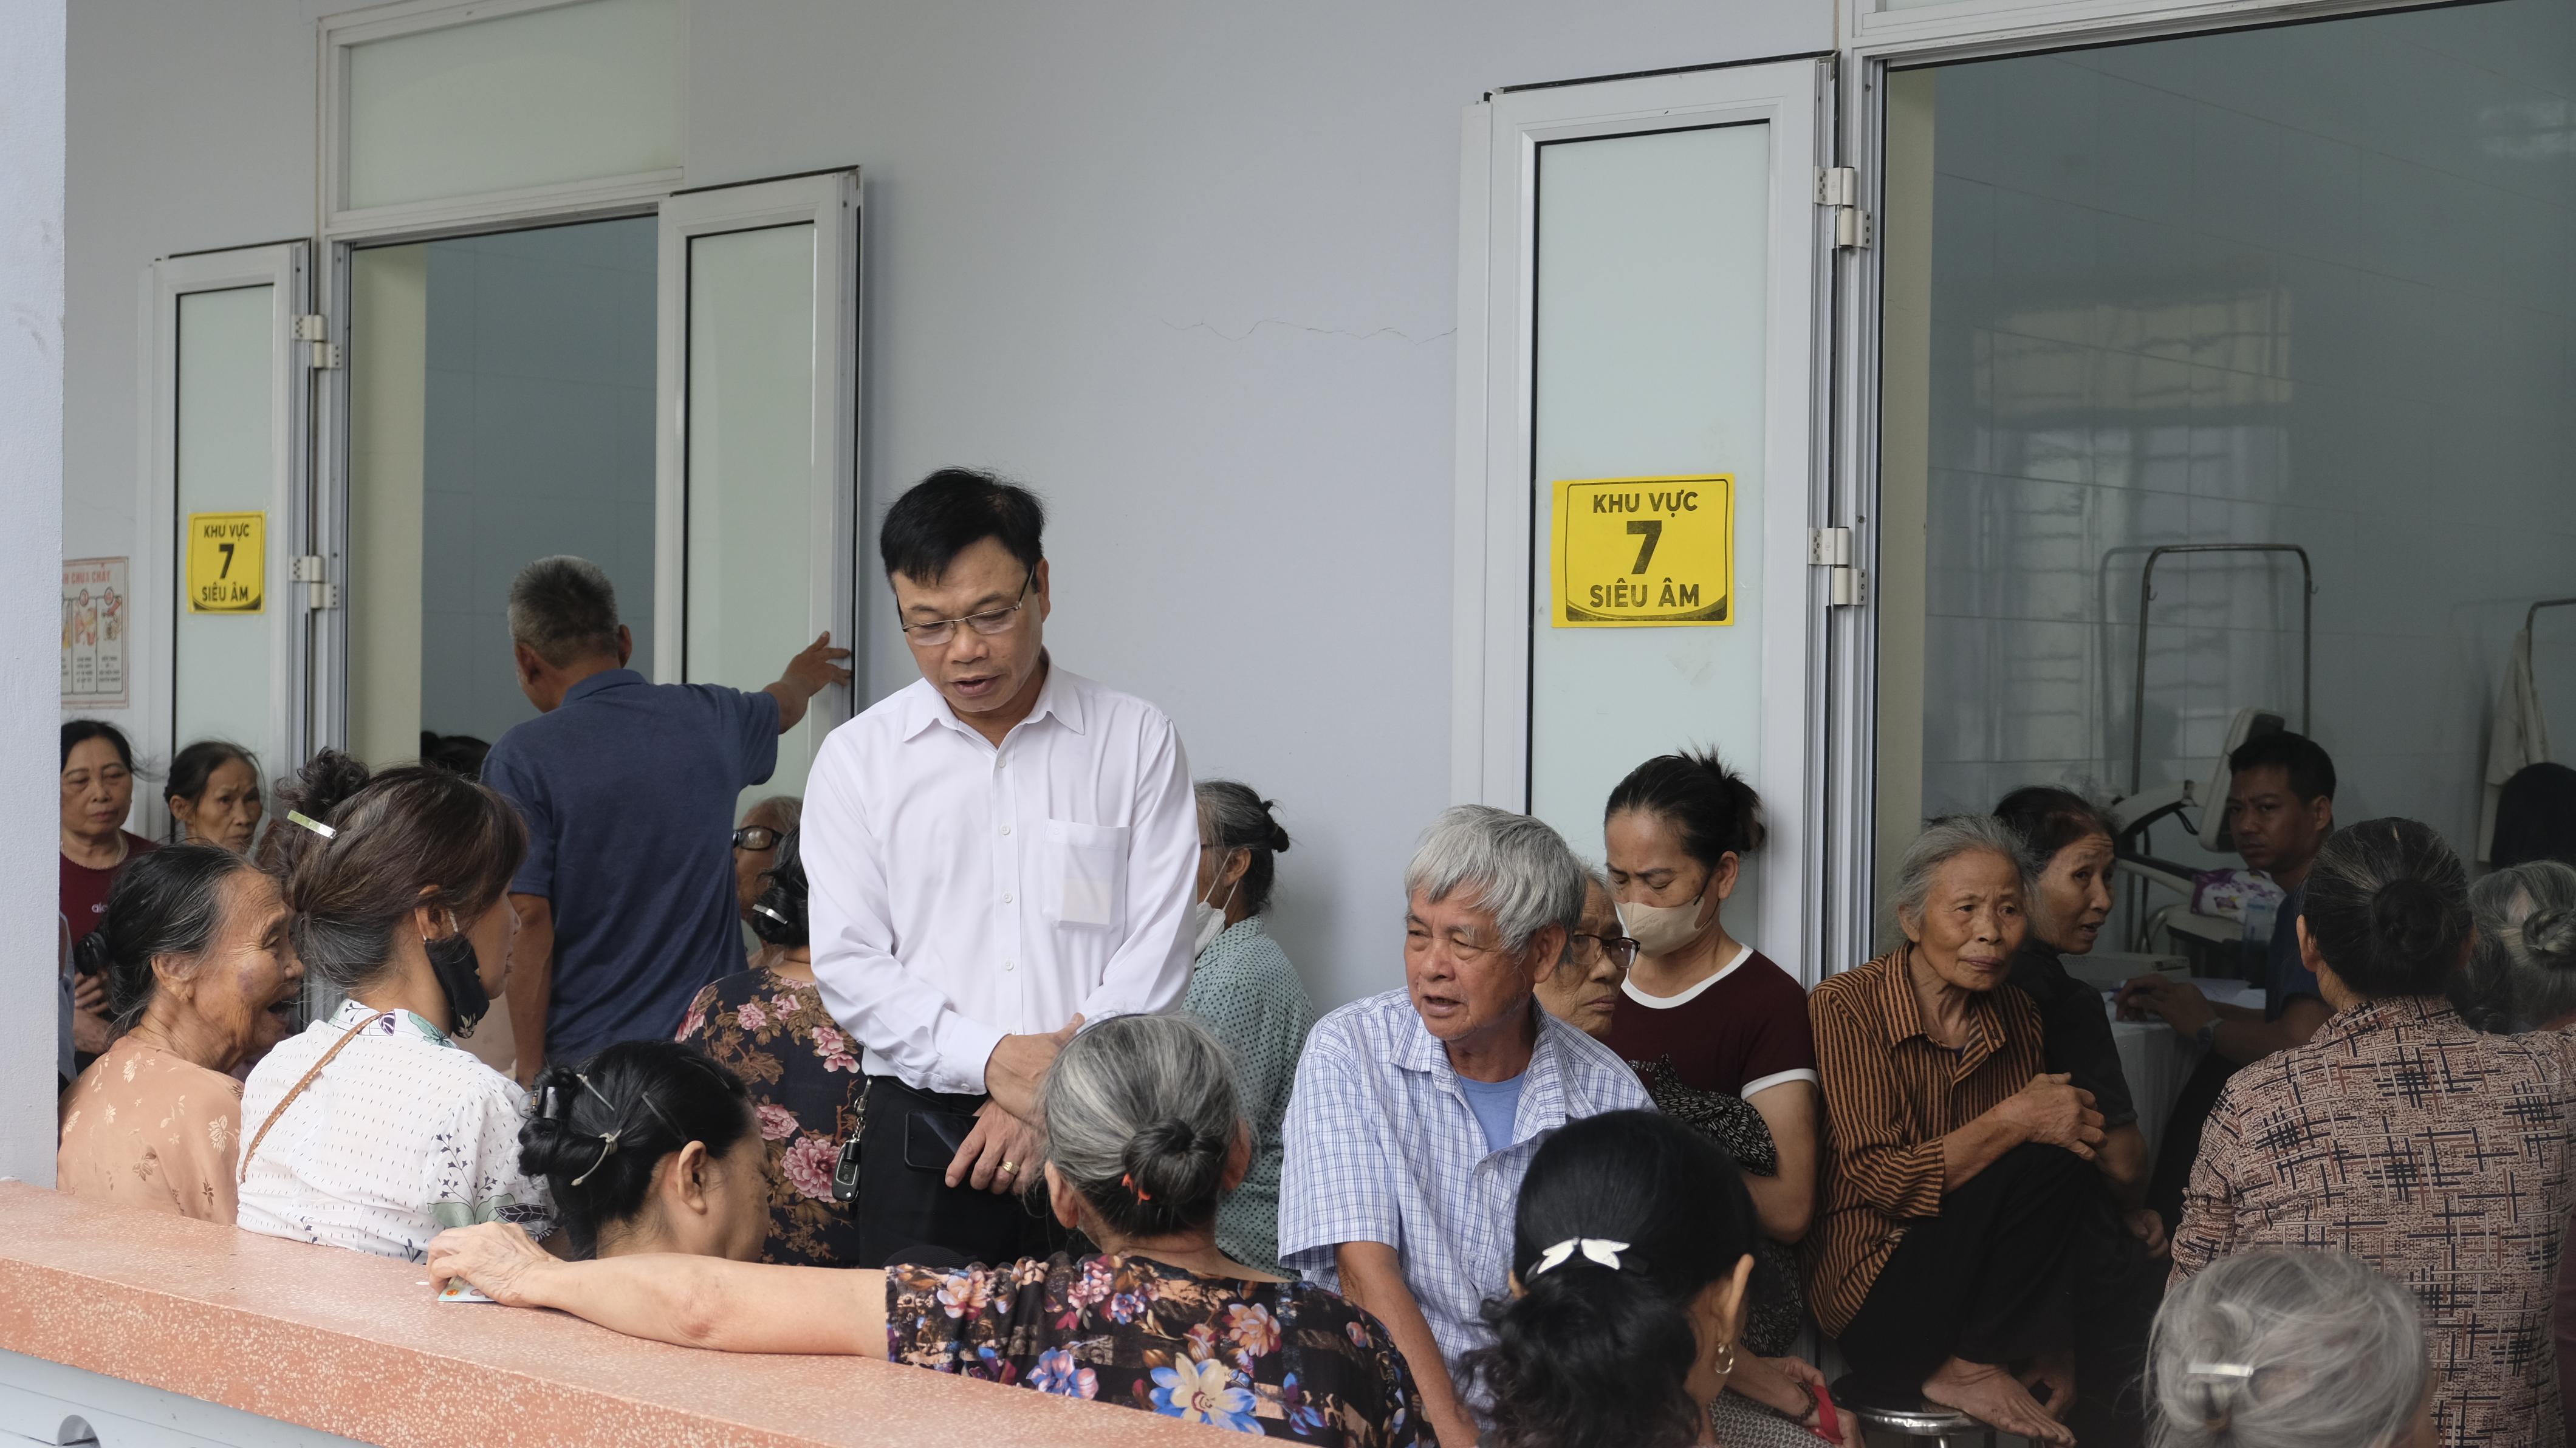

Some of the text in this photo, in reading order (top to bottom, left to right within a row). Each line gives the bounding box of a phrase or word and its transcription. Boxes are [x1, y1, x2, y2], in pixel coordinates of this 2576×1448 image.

[1592, 489, 1699, 517] KHU VỰC
[204, 522, 250, 542] KHU VỰC
[219, 543, 235, 579] 7
[1626, 520, 1662, 575] 7
[202, 581, 249, 602] SIÊU ÂM
[1589, 577, 1699, 608] SIÊU ÂM
